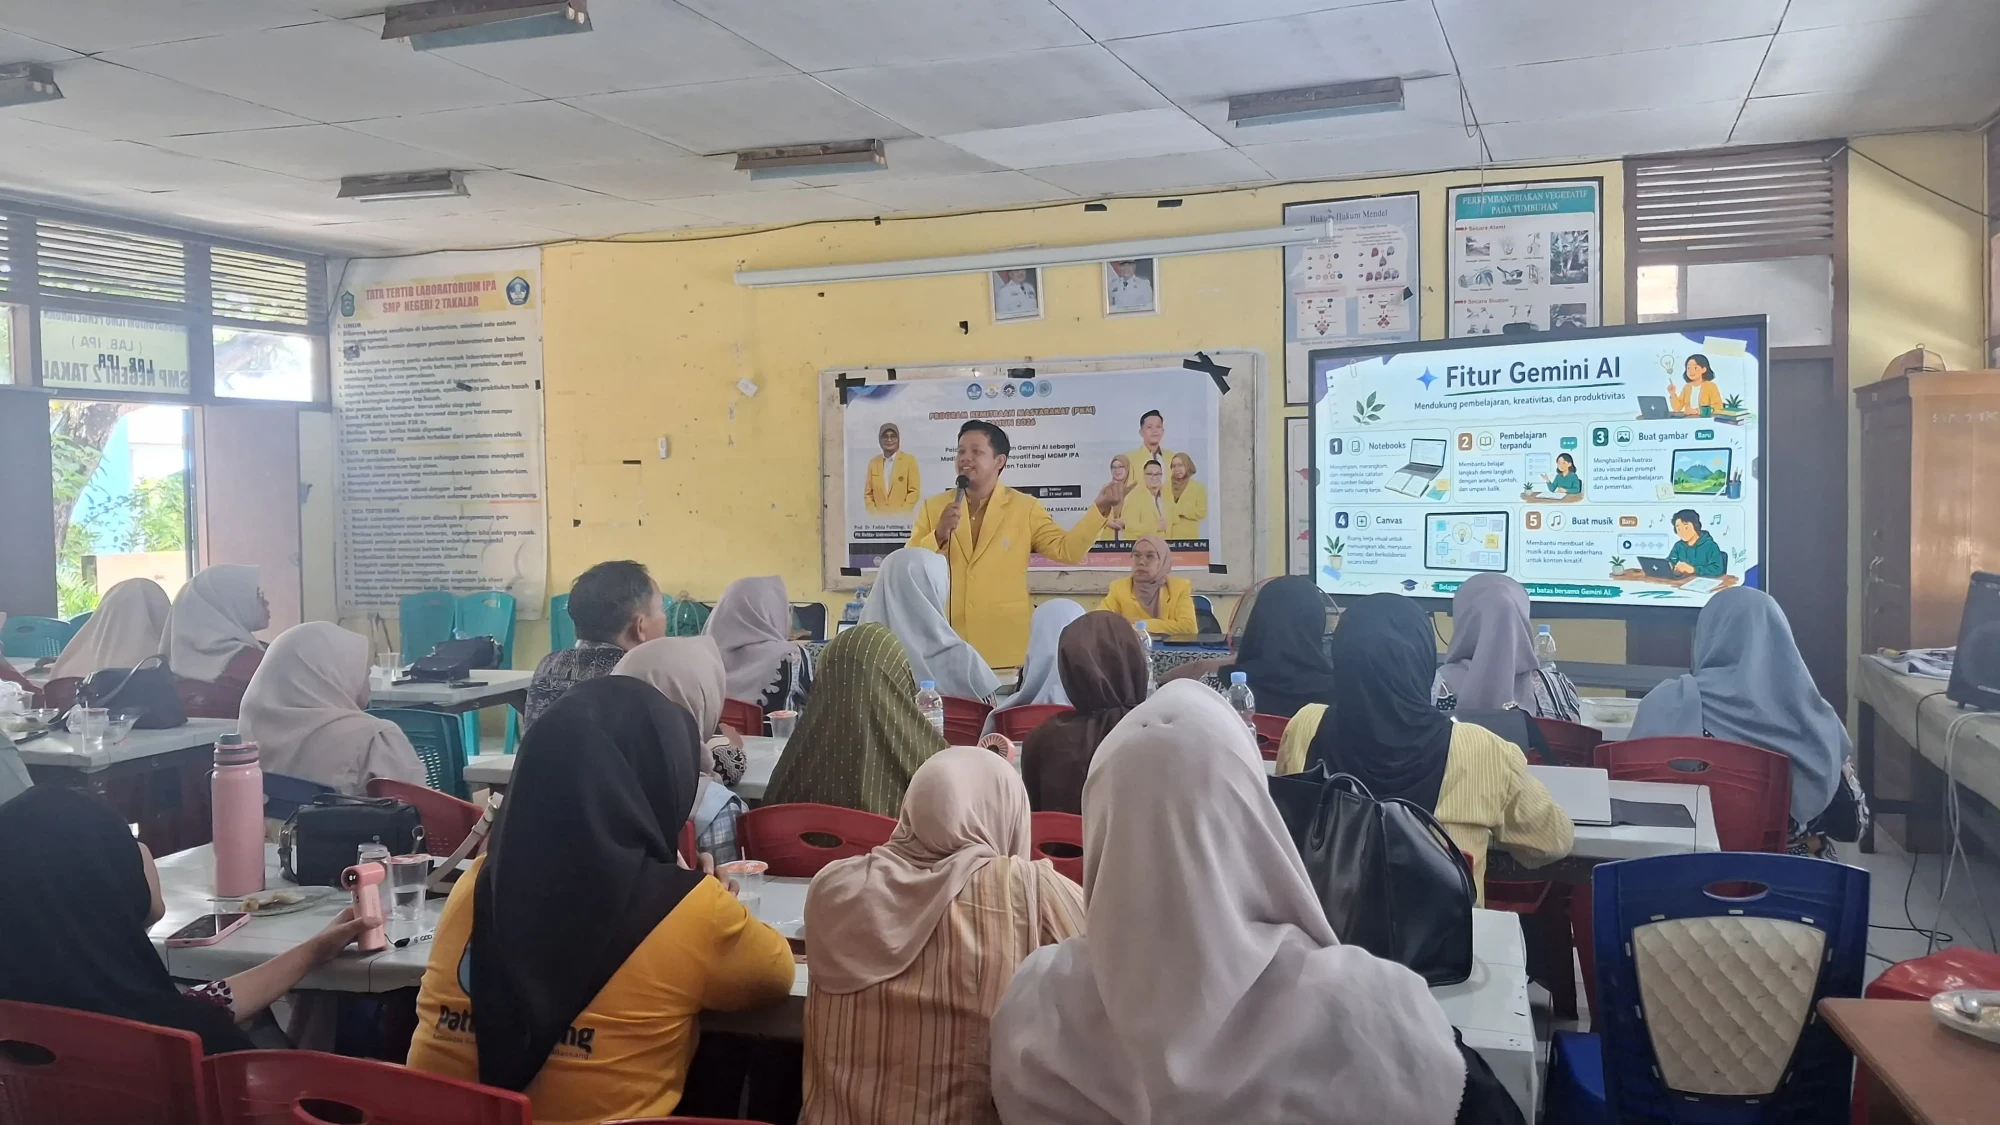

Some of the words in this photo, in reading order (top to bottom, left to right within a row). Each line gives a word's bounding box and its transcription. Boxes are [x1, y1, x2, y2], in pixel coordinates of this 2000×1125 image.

[1462, 192, 1543, 204] PERKEMBANGBIAKAN
[1544, 190, 1588, 199] VEGETATIF
[1362, 208, 1388, 218] Mendel
[1491, 206, 1512, 214] PADA
[1514, 202, 1558, 213] TUMBUHAN
[366, 288, 384, 300] TATA
[386, 286, 414, 298] TERTIB
[416, 281, 480, 296] LABORATORIUM
[483, 280, 496, 291] IPA
[382, 302, 401, 313] SMP
[404, 299, 432, 311] NEGERI
[435, 299, 440, 310] 2
[442, 296, 479, 309] TAKALAR
[1446, 365, 1502, 388] Fitur
[1510, 358, 1588, 385] Gemini
[1596, 356, 1620, 379] AI
[1414, 401, 1458, 410] Mendukung
[1459, 398, 1511, 409] pembelajaran,
[1513, 395, 1555, 405] kreativitas,
[1557, 394, 1572, 403] dan
[1574, 392, 1625, 404] produktivitas
[929, 411, 968, 420] PROGRAM
[970, 409, 1015, 418] KEMITRAAN
[1017, 407, 1070, 416] MASYARAKAT
[1072, 406, 1096, 416] (PKM)
[1016, 418, 1036, 426] 2026
[1500, 432, 1547, 441] Pembelajaran
[1596, 431, 1605, 443] 3
[1639, 432, 1656, 440] Buat
[1659, 432, 1688, 442] gambar
[1050, 443, 1076, 451] sebagai
[1332, 441, 1338, 452] 1
[1369, 442, 1406, 450] Notebooks
[1462, 437, 1469, 448] 2
[1500, 442, 1532, 450] terpandu
[1032, 453, 1046, 461] bagi
[1627, 474, 1664, 482] pembelajaran
[1338, 514, 1346, 526] 4
[1376, 516, 1402, 524] Canvas
[1529, 515, 1538, 526] 5
[1572, 517, 1589, 525] Buat
[1591, 517, 1613, 525] musik
